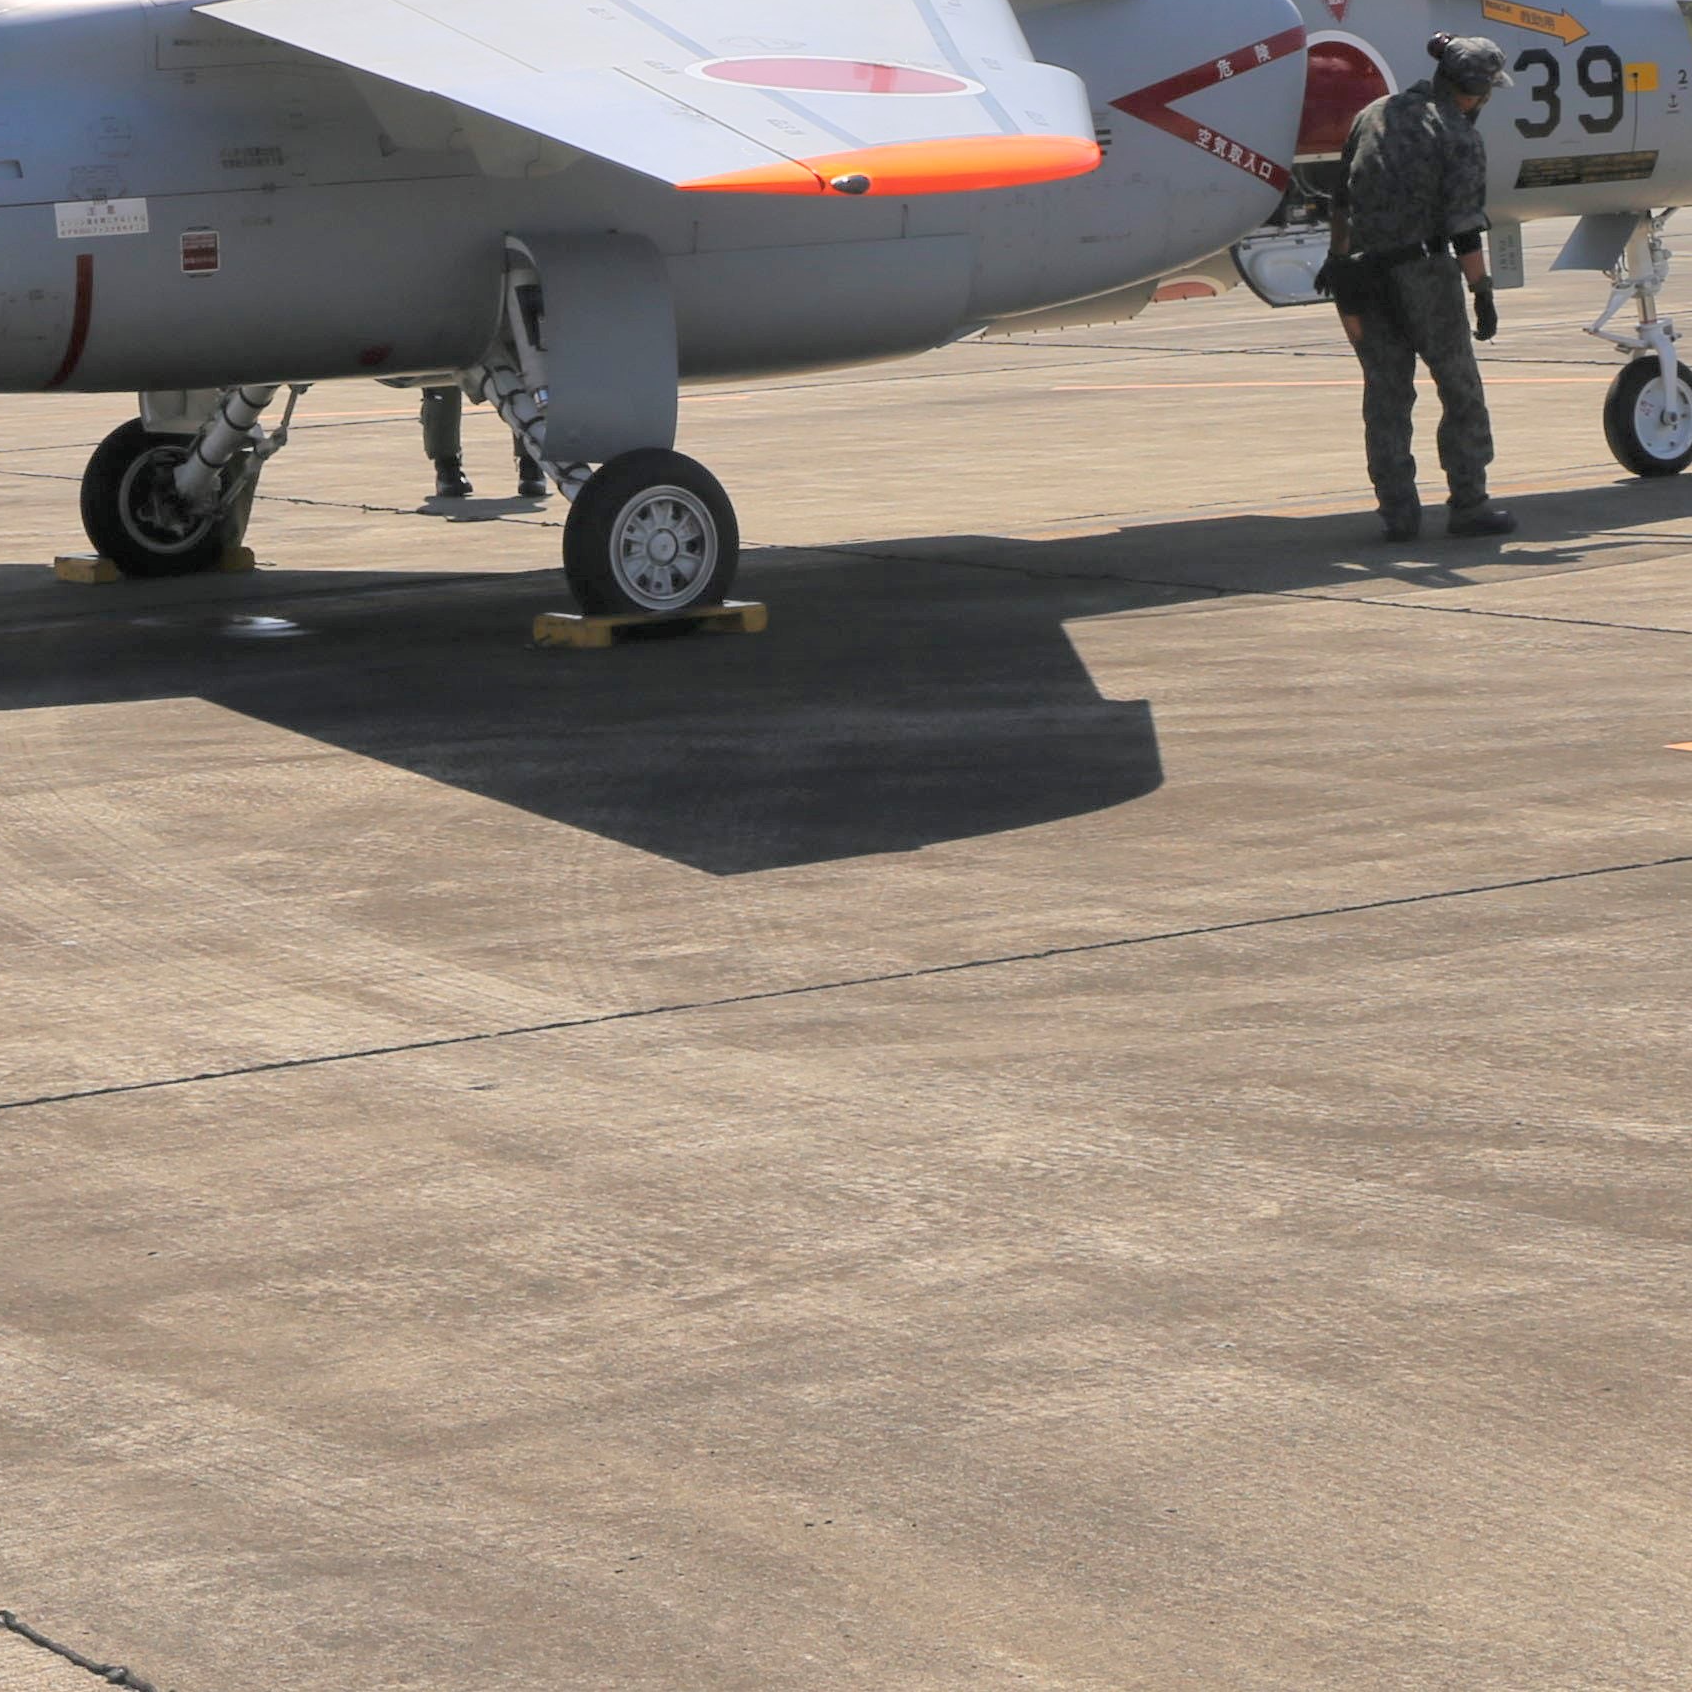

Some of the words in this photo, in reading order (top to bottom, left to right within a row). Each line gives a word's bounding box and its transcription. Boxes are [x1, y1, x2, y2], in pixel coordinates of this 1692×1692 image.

[1513, 45, 1624, 139] 39
[1195, 128, 1273, 179] 空気取入口
